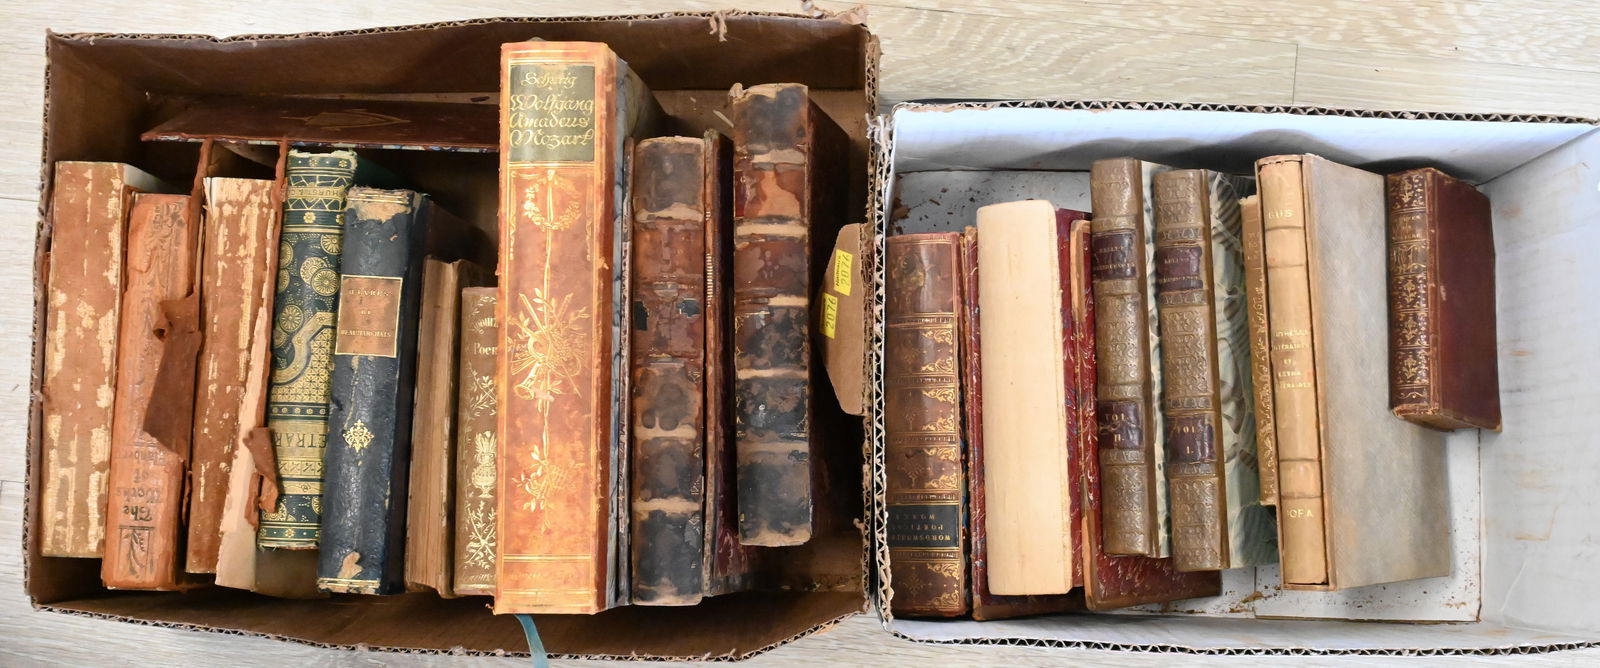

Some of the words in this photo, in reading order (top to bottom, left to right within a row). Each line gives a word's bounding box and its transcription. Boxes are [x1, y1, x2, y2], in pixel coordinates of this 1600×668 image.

[510, 93, 594, 116] Wolfgang
[510, 112, 590, 128] Amadeus
[510, 128, 594, 149] Mozart
[840, 253, 851, 286] 2076
[825, 297, 837, 330] 2076
[122, 505, 152, 522] The
